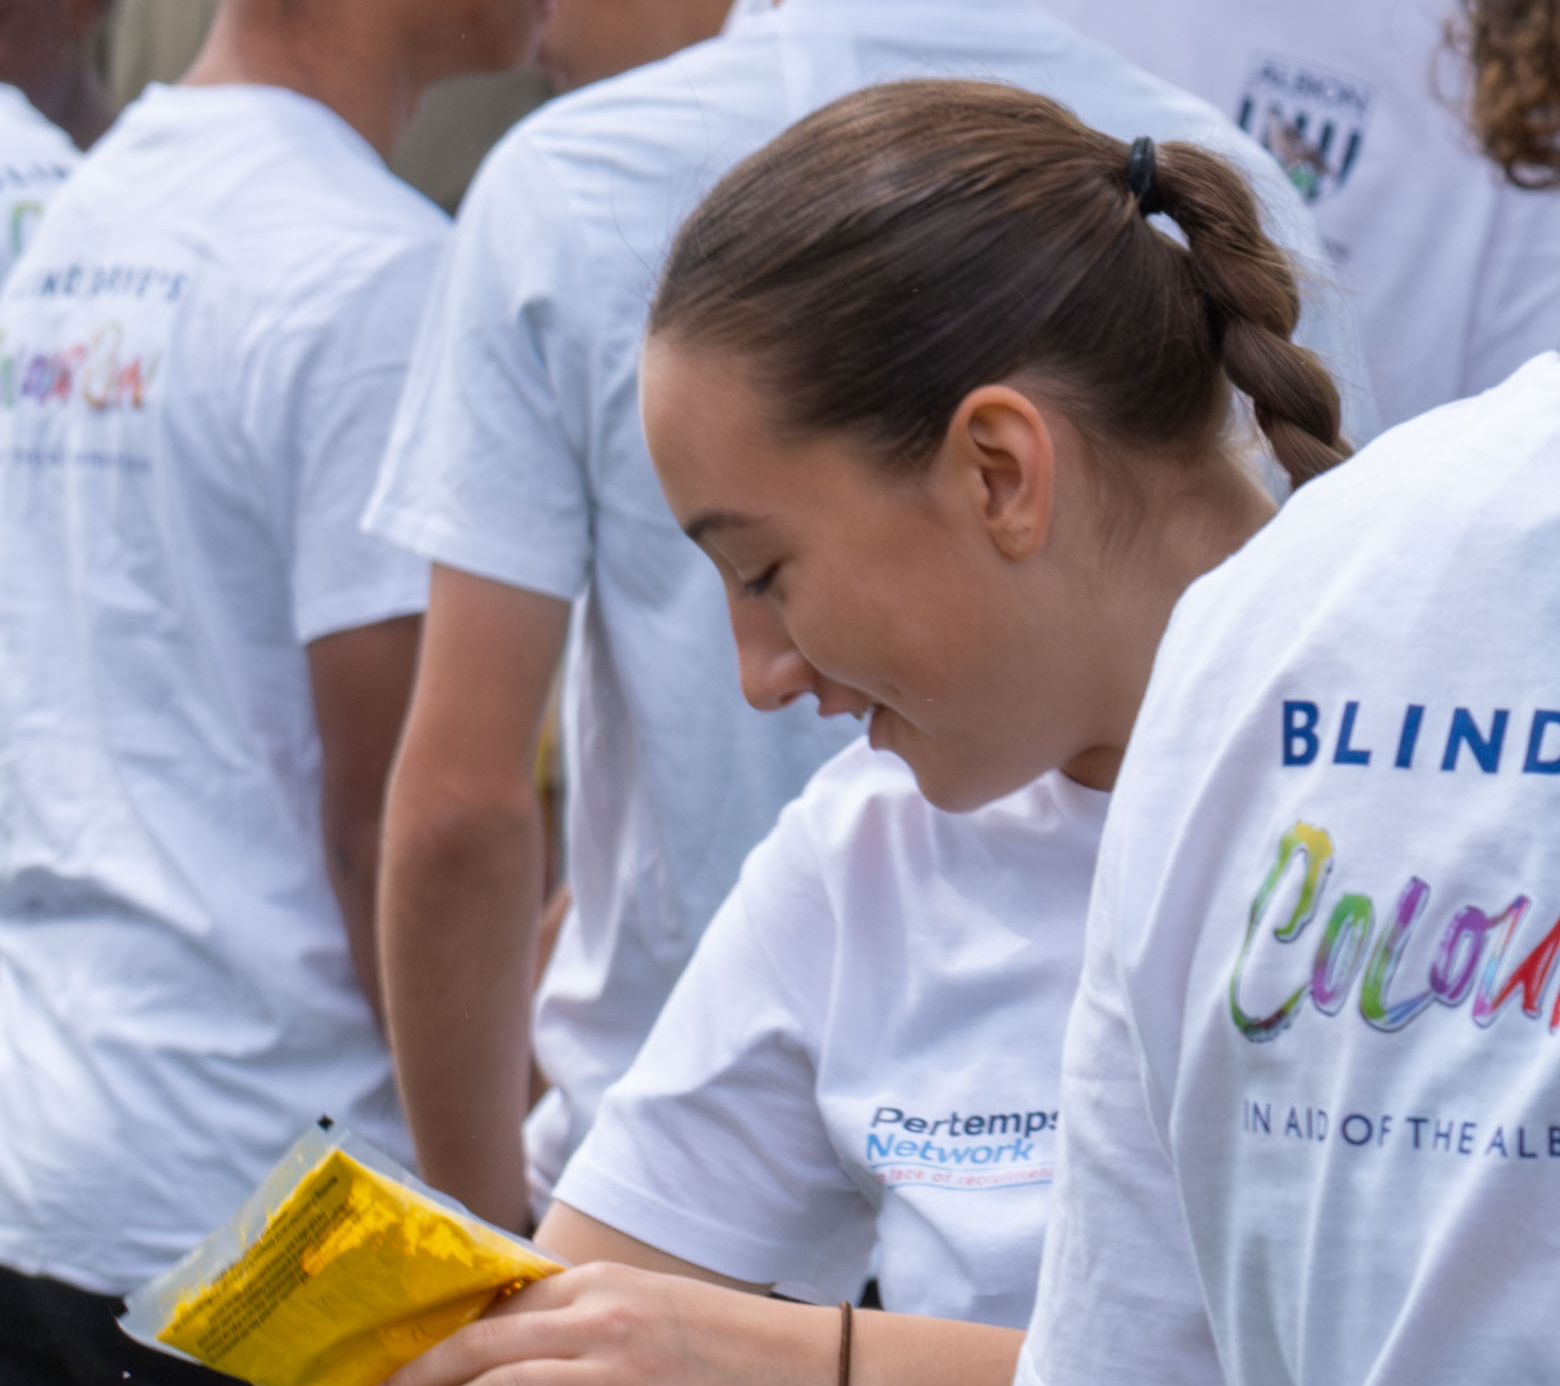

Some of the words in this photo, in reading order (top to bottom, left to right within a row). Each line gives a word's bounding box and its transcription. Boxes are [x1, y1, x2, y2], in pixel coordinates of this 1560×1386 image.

[866, 1133, 1034, 1164] Network
[1244, 1100, 1272, 1136] IN
[1285, 1105, 1329, 1143] AID
[1340, 1114, 1392, 1147] OF
[1406, 1117, 1477, 1155] THE
